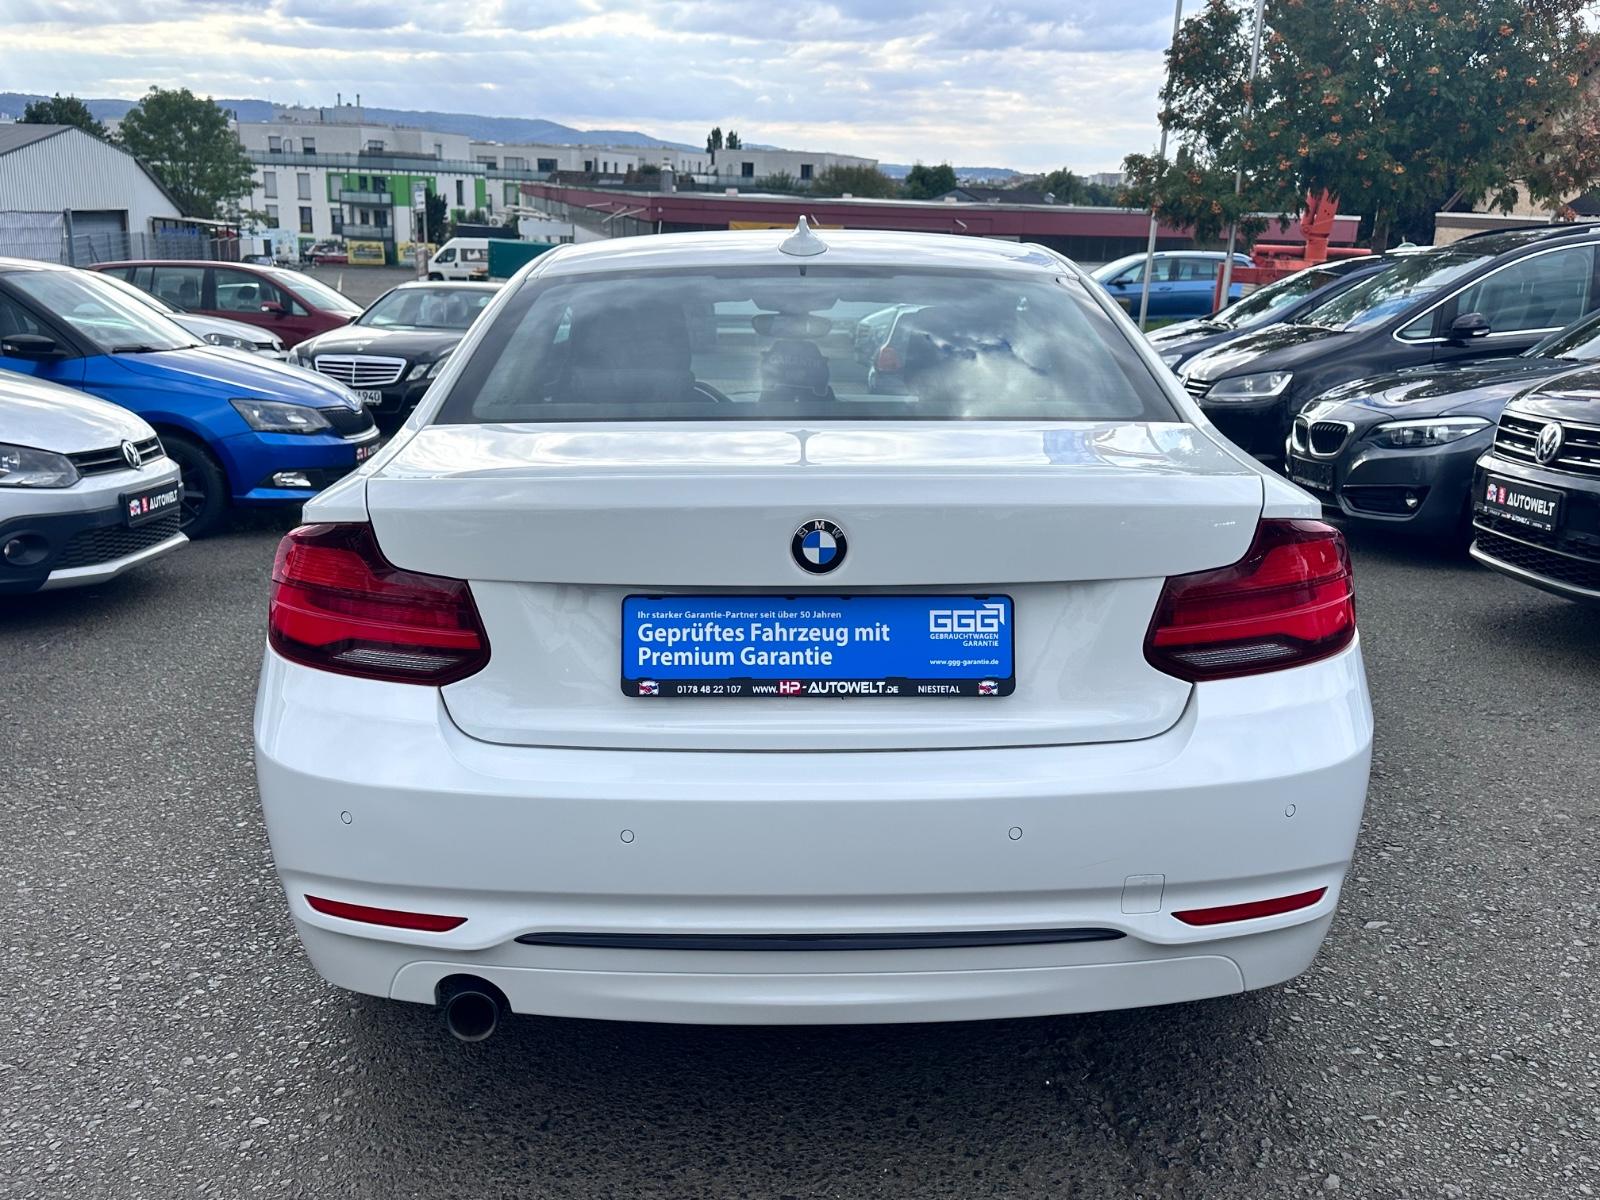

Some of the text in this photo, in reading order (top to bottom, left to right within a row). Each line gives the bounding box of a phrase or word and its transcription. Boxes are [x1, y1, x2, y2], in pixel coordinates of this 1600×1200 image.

[149, 489, 178, 510] AUTOWELT
[1507, 492, 1556, 516] AUTOWELT
[637, 611, 842, 619] Ihr starker Garantie-Partner seit über 50 Jahren
[929, 609, 999, 633] GGG
[638, 622, 890, 646] Geprüftes Fahrzeug mit
[638, 646, 833, 666] Premium Garantie
[929, 658, 999, 667] www.ggg-garantie.de
[677, 685, 698, 694] 0178
[700, 685, 711, 694] 48
[713, 685, 724, 694] 22
[726, 685, 742, 694] 107
[917, 685, 960, 694] NIESTETAL
